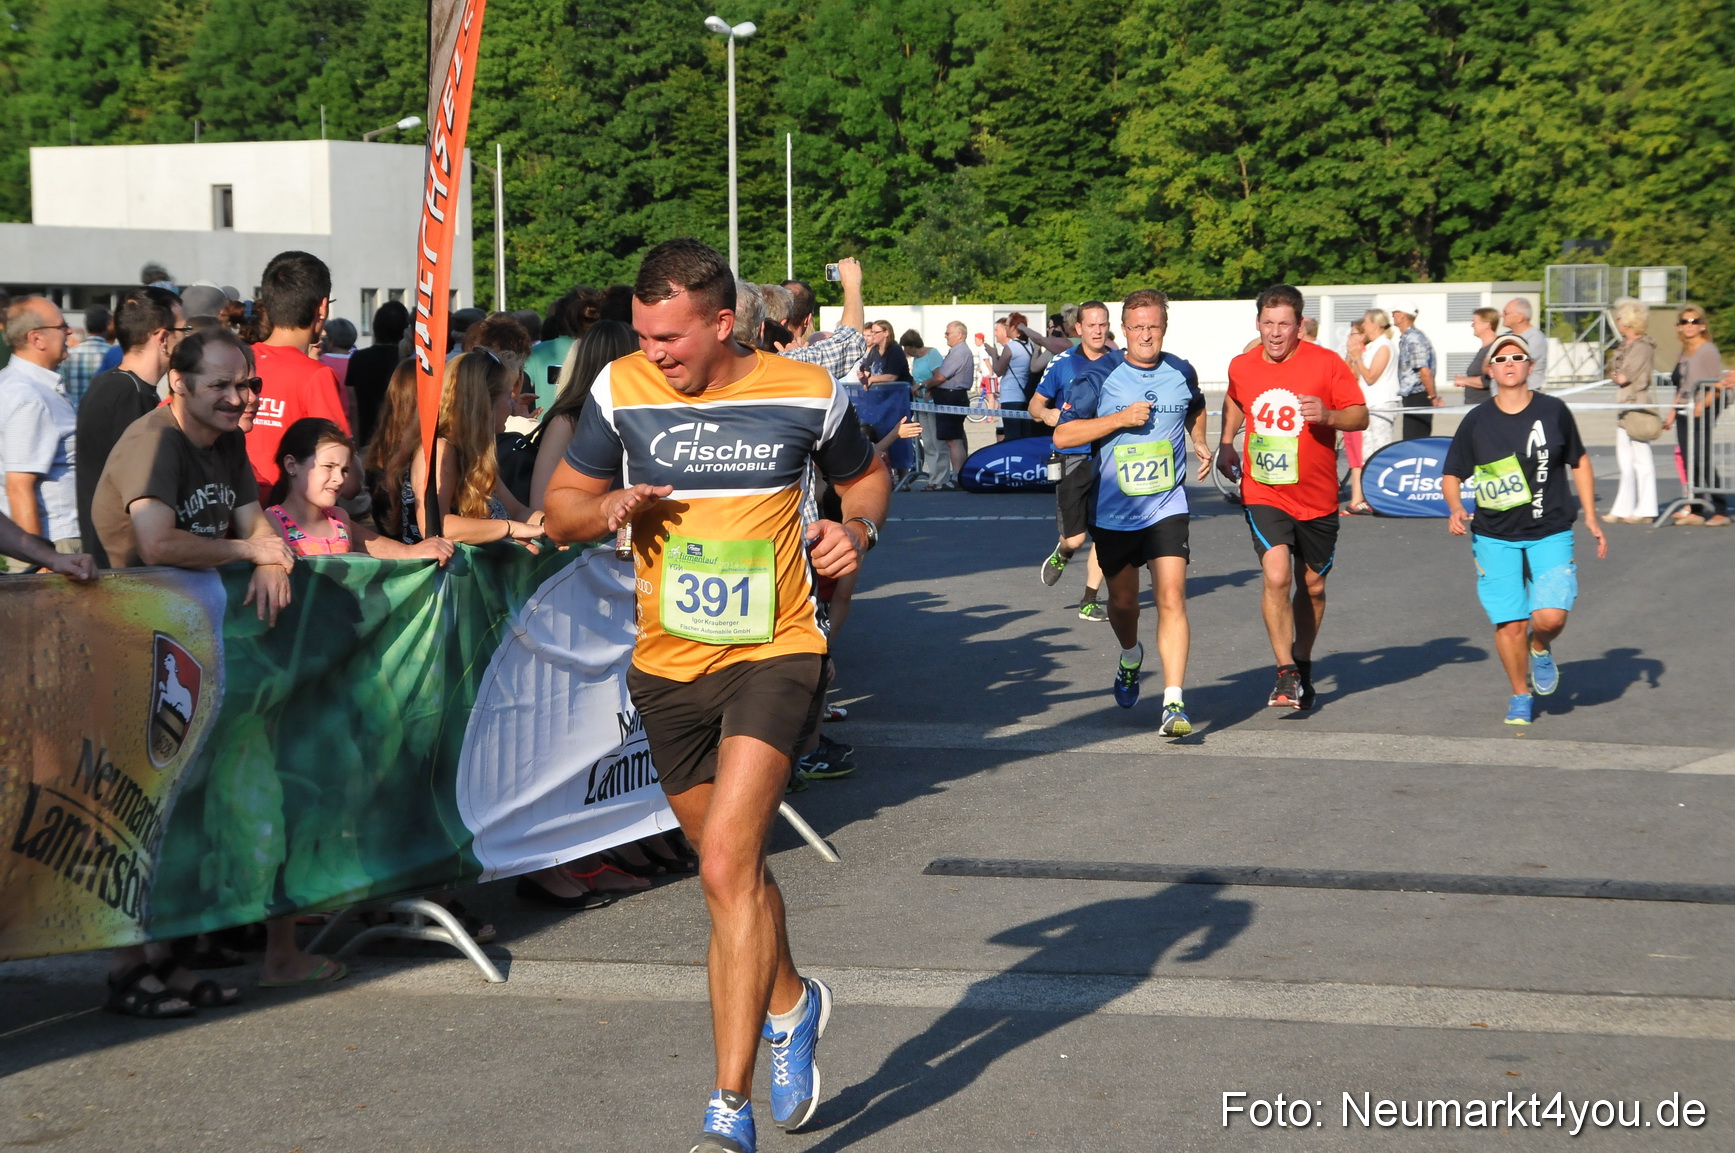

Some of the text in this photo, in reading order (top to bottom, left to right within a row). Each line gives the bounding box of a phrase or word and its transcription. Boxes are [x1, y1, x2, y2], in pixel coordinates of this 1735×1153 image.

[1257, 402, 1296, 431] 48
[673, 440, 784, 462] Fischer
[1256, 452, 1288, 471] 464
[683, 462, 776, 473] AUTOMOBILE
[1119, 458, 1169, 482] 1221
[1537, 449, 1549, 483] ONE
[1476, 475, 1524, 501] 1048
[676, 573, 750, 618] 391
[680, 624, 700, 632] Fischer
[700, 626, 733, 635] Automobile
[692, 617, 739, 627] Igor Krauberger
